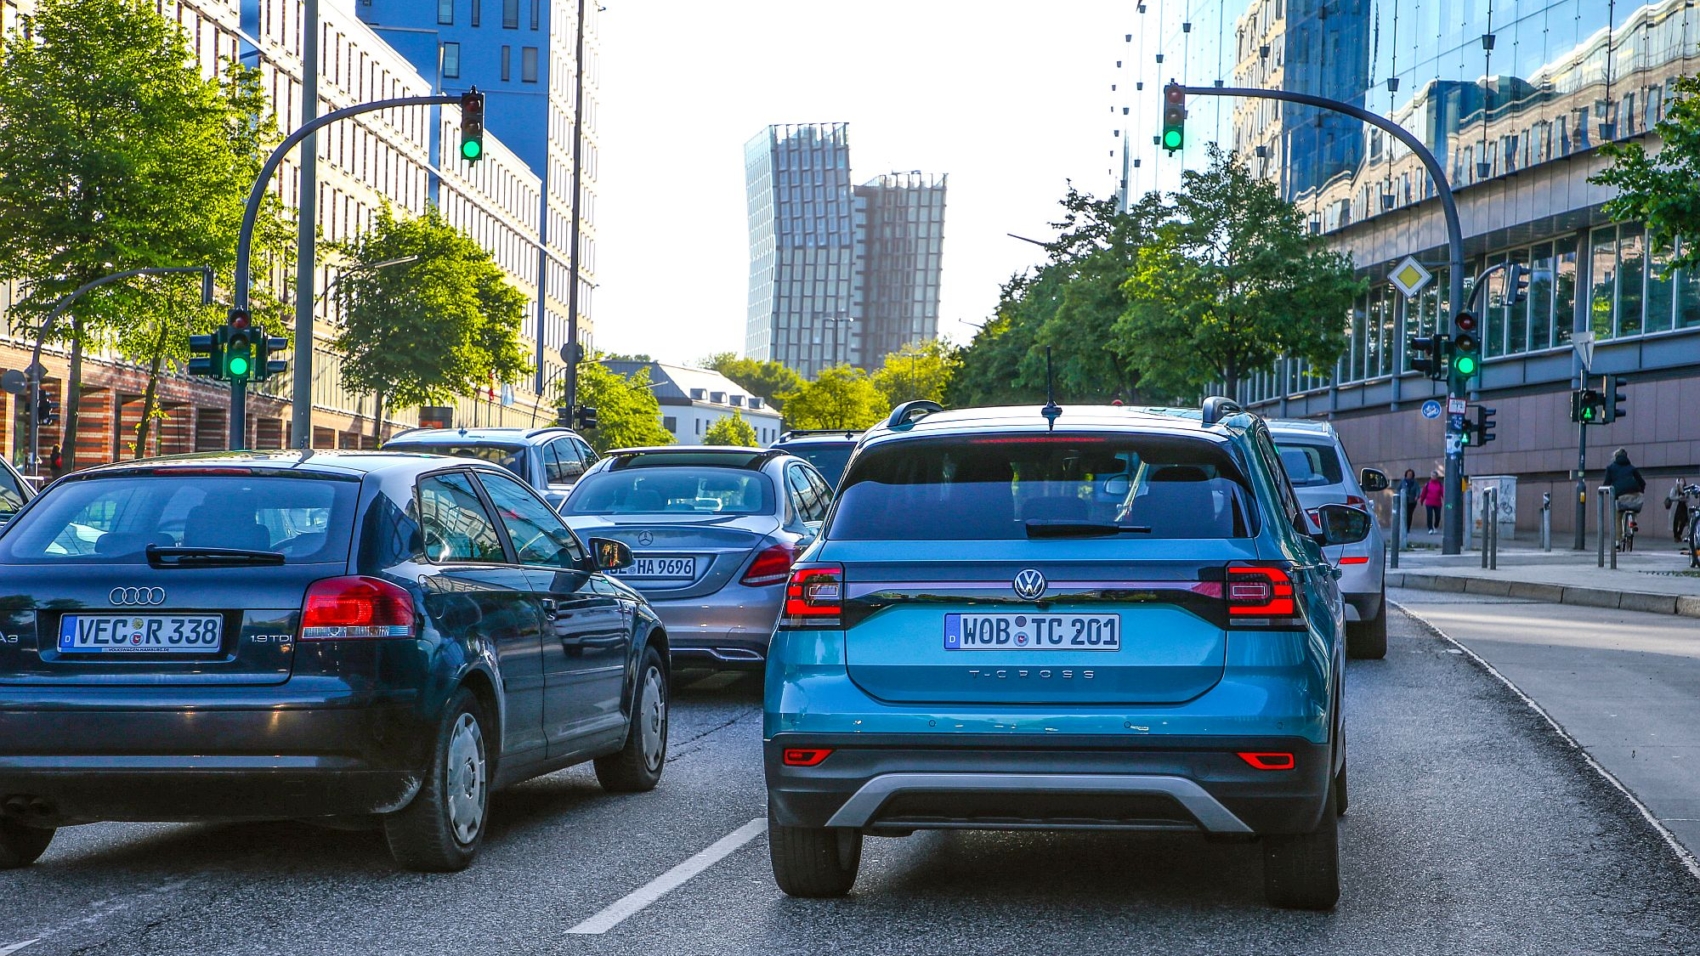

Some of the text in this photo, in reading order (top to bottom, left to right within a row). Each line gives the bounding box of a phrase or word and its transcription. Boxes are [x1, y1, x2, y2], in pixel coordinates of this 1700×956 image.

[637, 559, 654, 574] HA
[658, 559, 691, 574] 9696
[78, 619, 128, 644] VEC
[145, 619, 163, 644] R
[168, 619, 218, 644] 338
[949, 618, 1118, 645] D WOB TC 201
[969, 669, 1095, 679] T-CROSS
